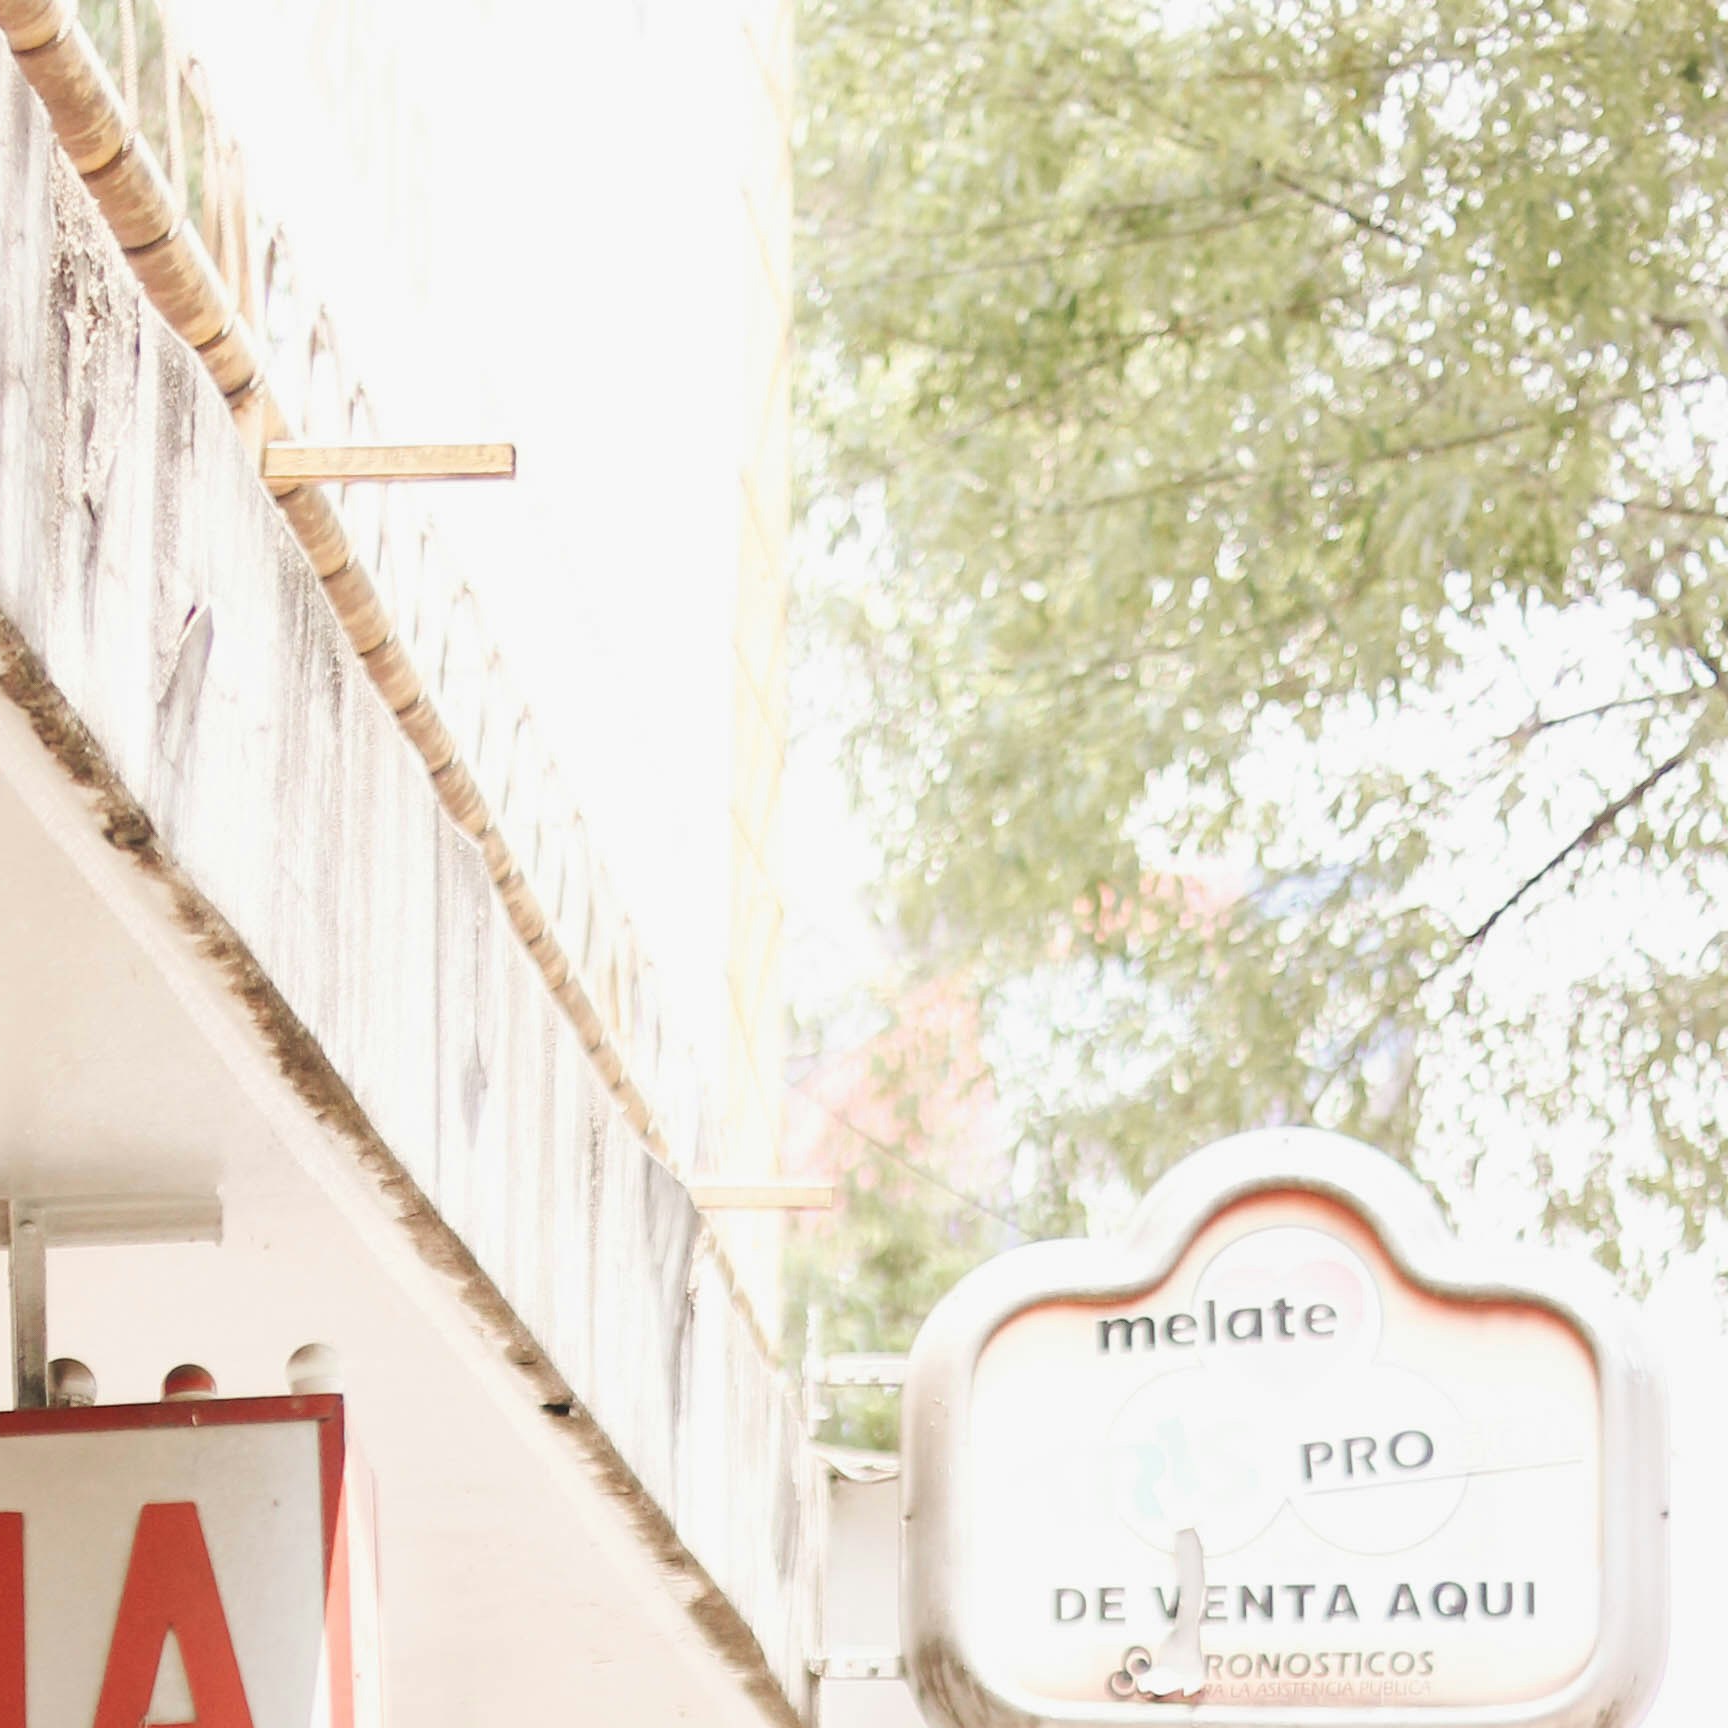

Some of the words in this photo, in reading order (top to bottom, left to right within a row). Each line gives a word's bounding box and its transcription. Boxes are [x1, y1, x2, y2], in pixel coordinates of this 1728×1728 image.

[1096, 1297, 1338, 1354] melate
[1300, 1429, 1435, 1482] PRO
[1054, 1586, 1126, 1623] DE
[1387, 1580, 1536, 1622] AQUI
[1203, 1650, 1435, 1680] RONOSTICOS
